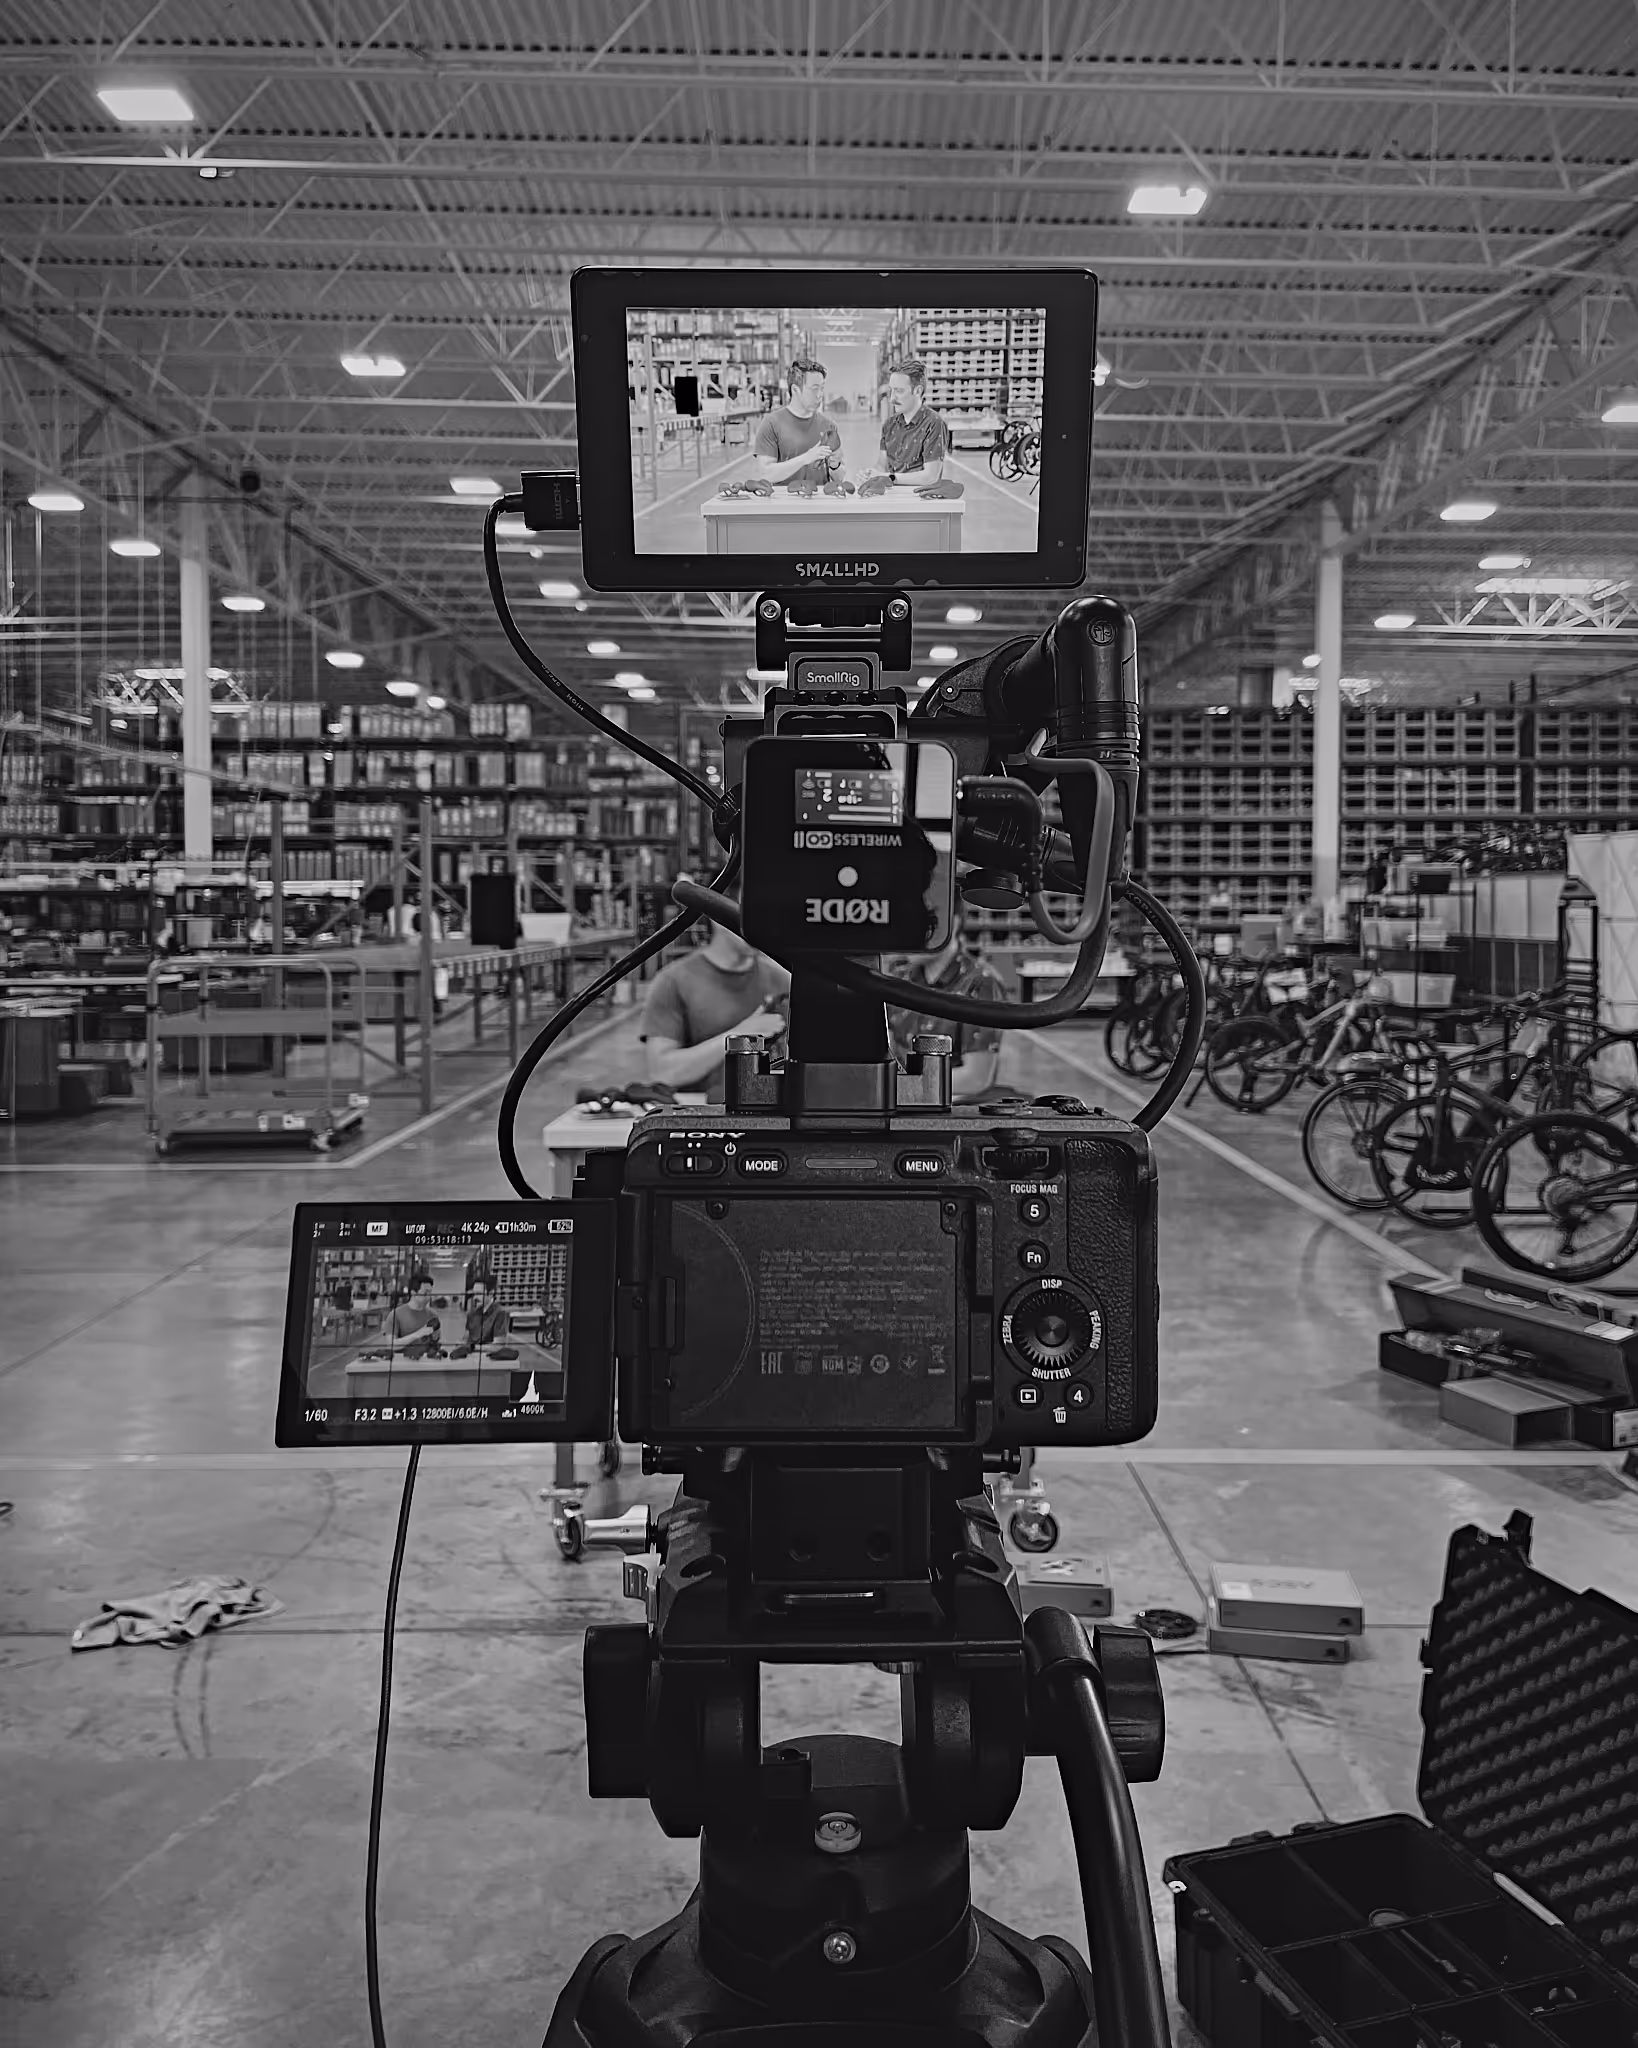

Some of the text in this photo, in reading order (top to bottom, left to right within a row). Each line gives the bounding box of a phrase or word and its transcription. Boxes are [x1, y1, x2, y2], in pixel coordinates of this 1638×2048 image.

[795, 562, 880, 577] SMALLHD
[807, 671, 860, 686] SmallRig
[834, 833, 902, 848] WIRELESS
[805, 898, 890, 924] RØDE
[669, 1131, 746, 1139] SONY
[745, 1160, 779, 1172] MODE
[905, 1160, 938, 1172] MENU
[1010, 1183, 1058, 1194] FOCUS MAG
[1029, 1204, 1040, 1218] 5
[461, 1221, 490, 1234] 4K 24p
[510, 1221, 537, 1233] 1h30m
[1026, 1251, 1042, 1263] Fn
[1041, 1278, 1063, 1290] DISP
[1002, 1314, 1014, 1345] ZEBRA
[1088, 1309, 1102, 1350] PEAKING
[1031, 1367, 1072, 1381] SHUTTER
[1073, 1389, 1084, 1403] 4
[304, 1408, 329, 1422] 1/60
[354, 1408, 378, 1421] F3.2
[394, 1407, 418, 1421] +1.3
